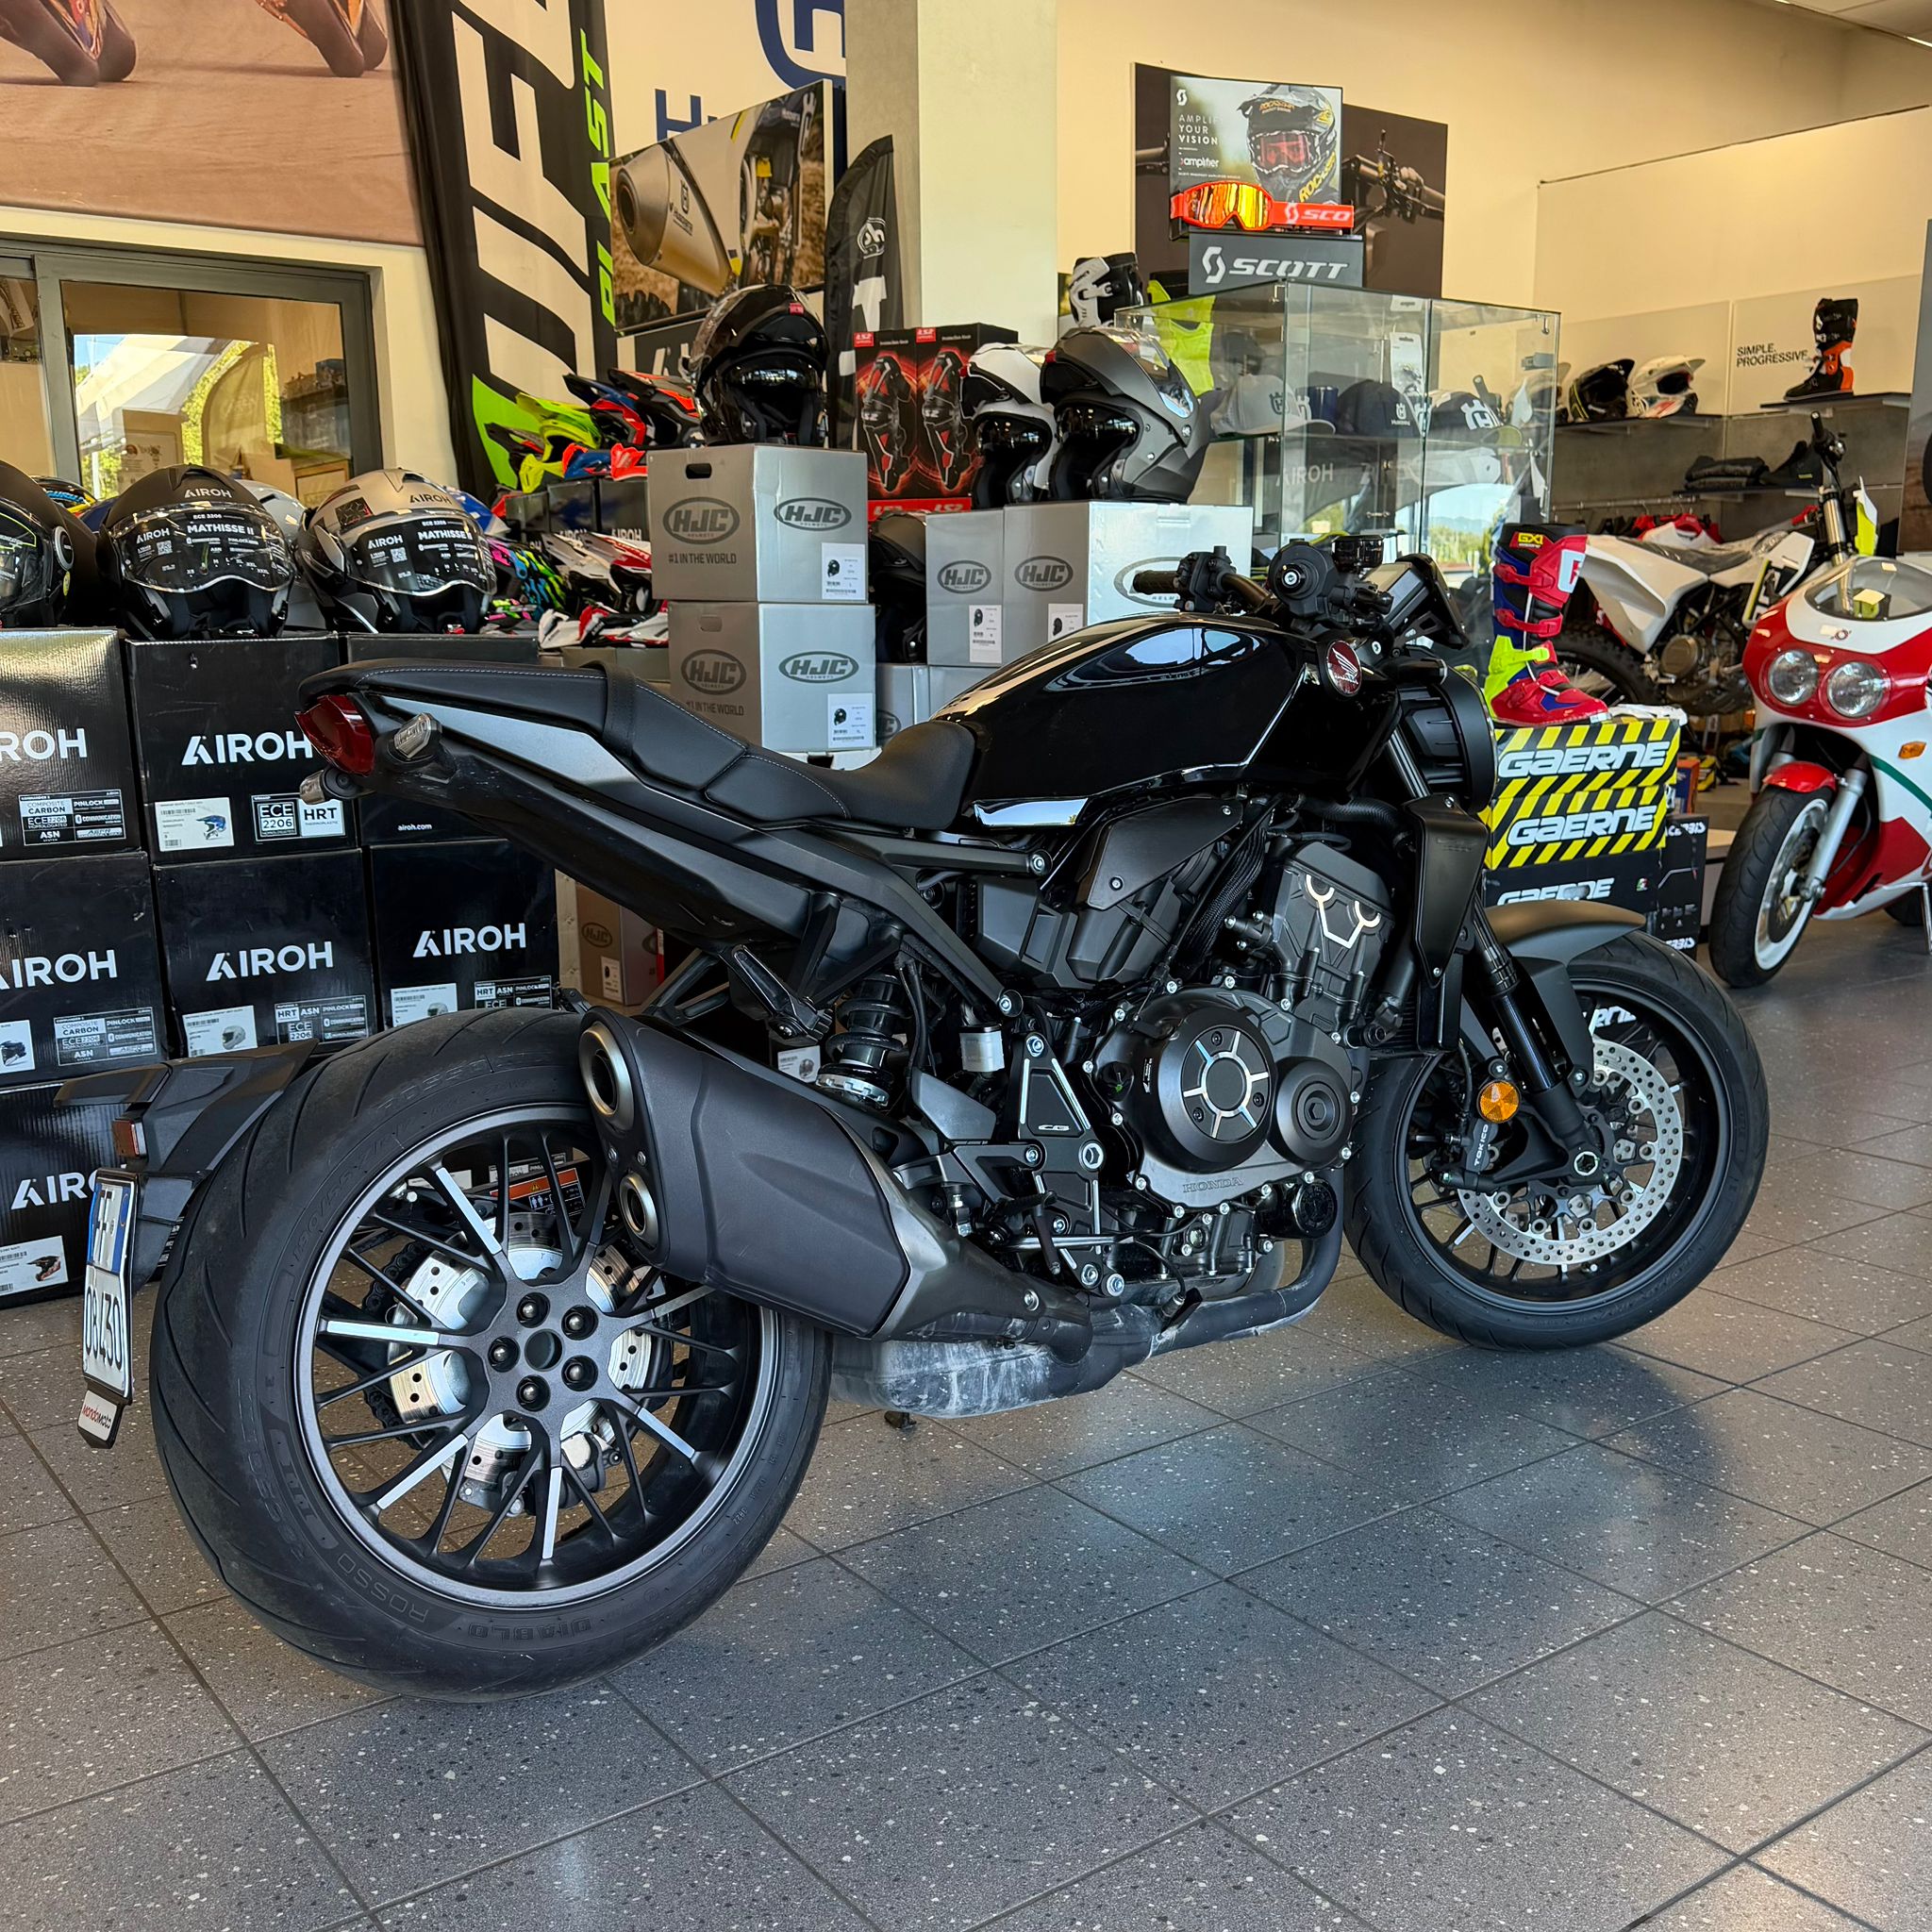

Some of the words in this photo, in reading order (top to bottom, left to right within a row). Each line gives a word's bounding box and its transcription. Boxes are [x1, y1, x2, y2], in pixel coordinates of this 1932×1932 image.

[1179, 125, 1208, 134] YOUR
[1178, 135, 1218, 145] VISION
[1183, 158, 1219, 168] amplifier
[1229, 258, 1348, 279] SCOTT
[1737, 343, 1776, 357] SIMPLE.
[184, 488, 233, 499] AIROH
[409, 494, 452, 505] AIROH
[673, 508, 729, 533] HJC
[785, 506, 842, 524] HJC
[136, 527, 171, 544] AIROH
[188, 525, 245, 535] MATHISSE
[247, 527, 255, 536] II
[418, 529, 466, 541] MATHISSE
[368, 535, 403, 550] AIROH
[679, 553, 688, 564] IN
[689, 553, 705, 564] THE
[706, 553, 737, 564] WORLD
[944, 569, 984, 586] HJC
[1022, 565, 1065, 583] HJC
[689, 658, 738, 684] HJC
[791, 659, 850, 675] HJC
[703, 703, 716, 713] THE
[717, 704, 744, 716] WORLD
[181, 730, 313, 766] AIROH
[1497, 741, 1671, 778] GAERNE
[28, 807, 65, 815] CARBON
[261, 805, 294, 817] ECE
[304, 807, 338, 821] HRT
[27, 817, 48, 825] ECE
[263, 818, 292, 829] 2206
[1507, 805, 1657, 846] GAERNE
[41, 831, 60, 840] ASN
[412, 923, 526, 958] AIROH
[206, 941, 334, 982] AIROH
[476, 988, 494, 996] HRT
[496, 986, 513, 995] ASN
[485, 1000, 507, 1008] ECE
[277, 1009, 297, 1019] HRT
[300, 1007, 320, 1016] ASN
[62, 1026, 99, 1036] CARBON
[289, 1022, 312, 1032] ECE
[62, 1038, 81, 1046] ECE
[291, 1031, 312, 1041] 2206
[75, 1050, 93, 1058] ASN
[1474, 1124, 1489, 1166] TOKICO
[1183, 1176, 1245, 1193] HONDA
[86, 1286, 123, 1371] 08430
[337, 1552, 430, 1624] ROSSO
[468, 1617, 592, 1641] DIABLO
